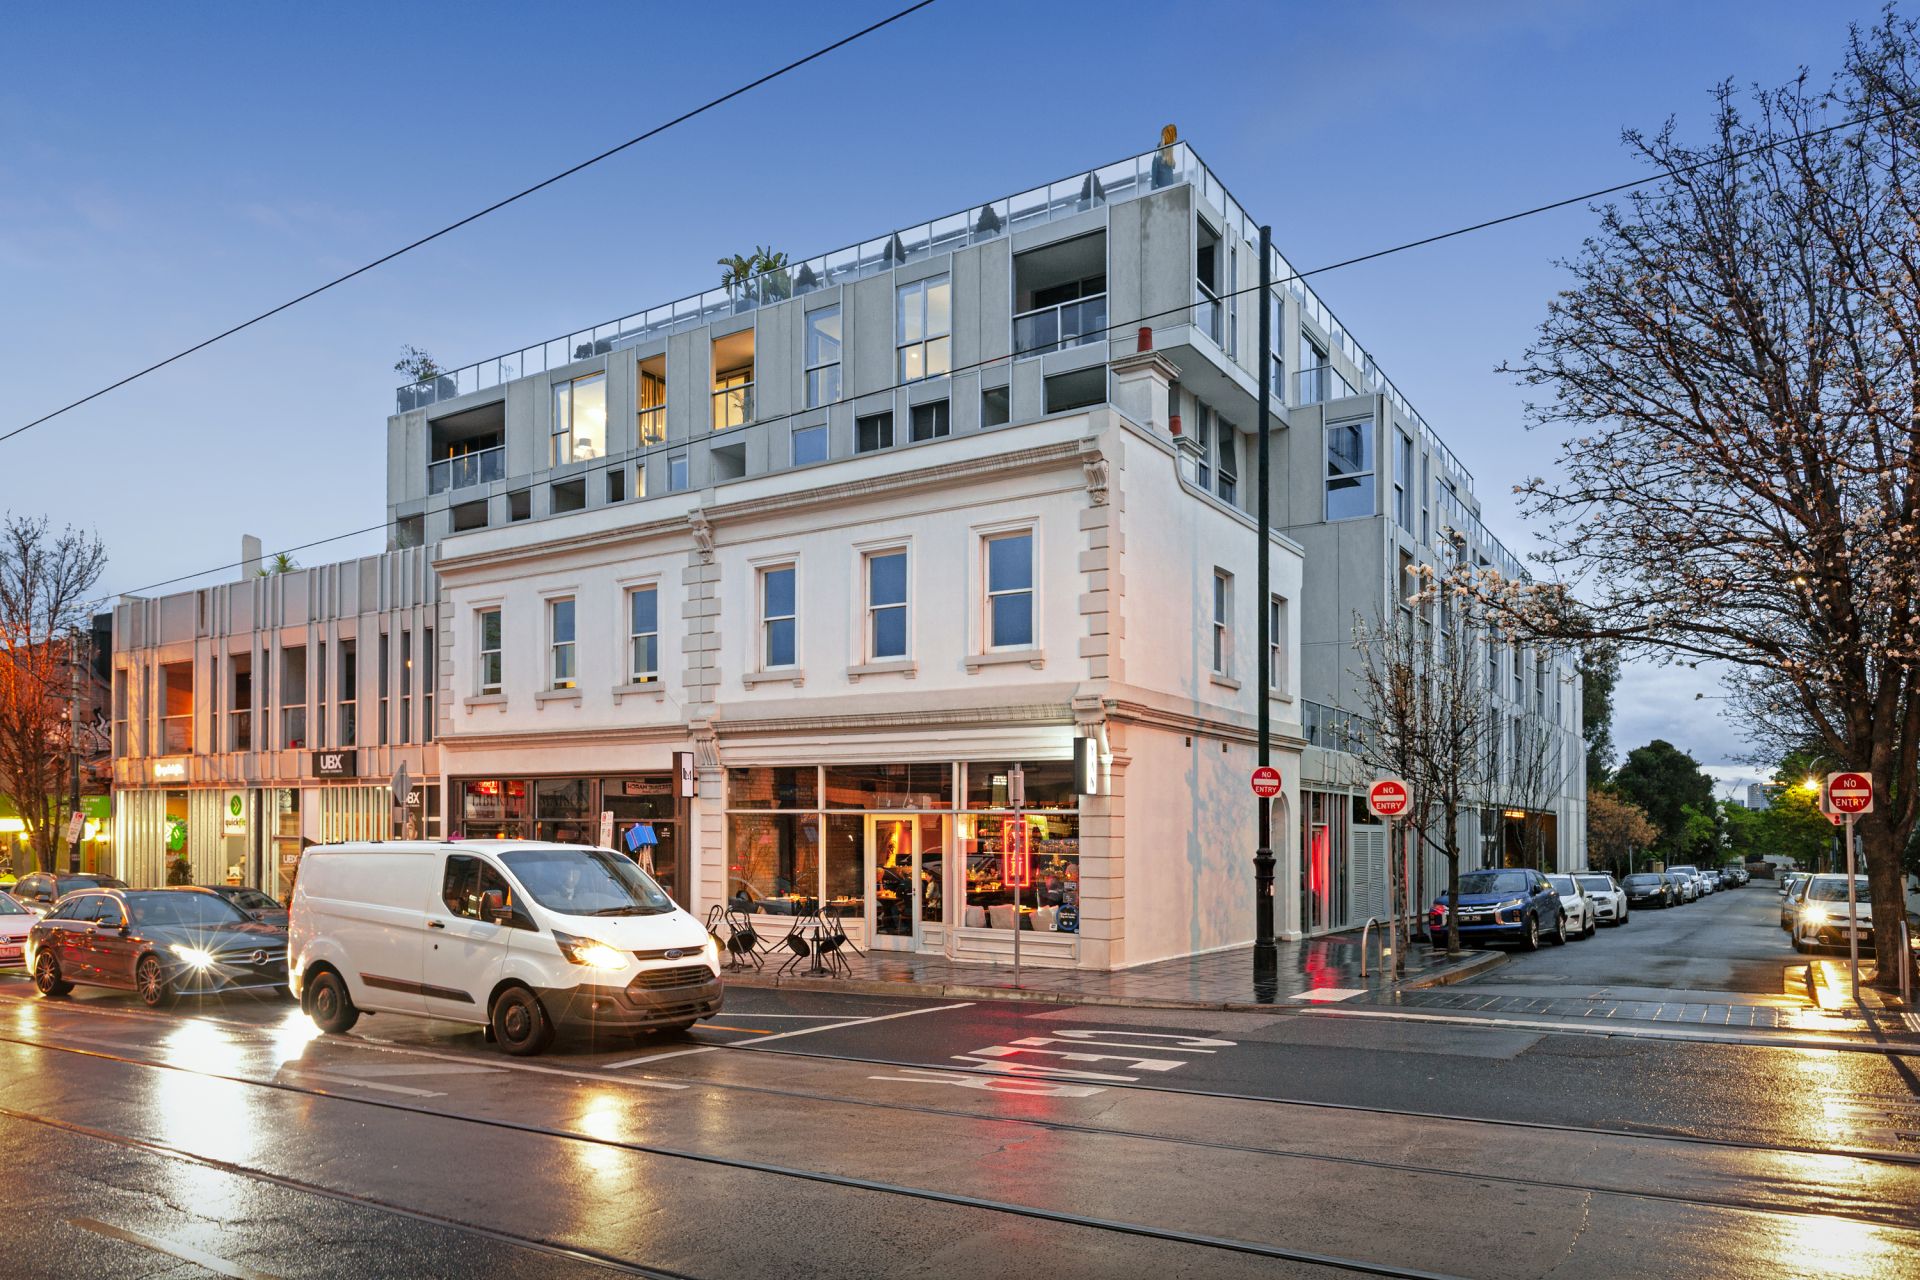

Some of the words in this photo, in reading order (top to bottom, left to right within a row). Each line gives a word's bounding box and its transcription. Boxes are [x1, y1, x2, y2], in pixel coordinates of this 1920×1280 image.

[320, 754, 342, 770] UBX
[1843, 779, 1857, 788] NO
[1382, 786, 1395, 794] NO
[1376, 802, 1402, 810] ENTRY
[1835, 798, 1866, 807] ENTRY
